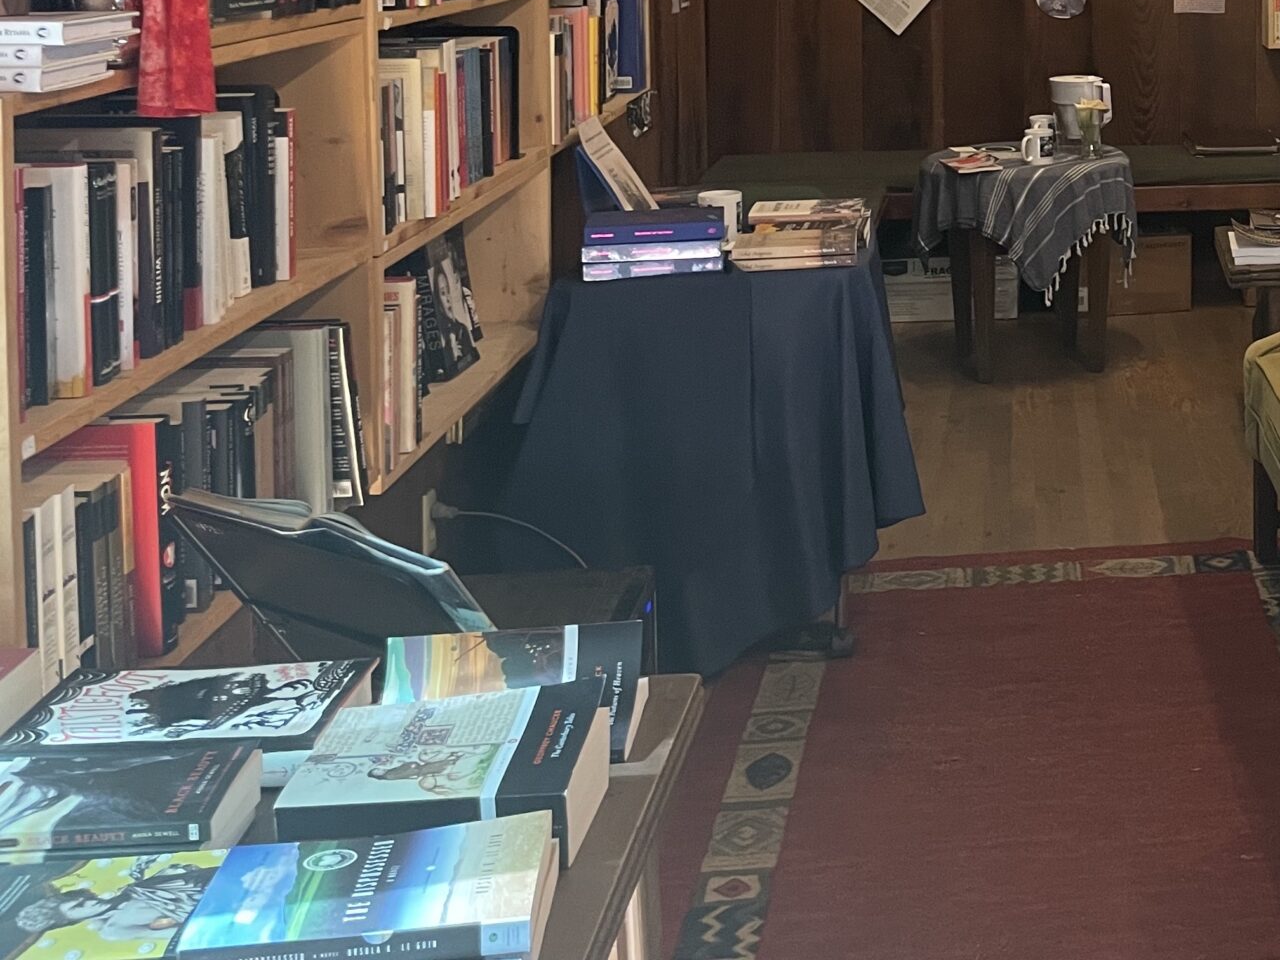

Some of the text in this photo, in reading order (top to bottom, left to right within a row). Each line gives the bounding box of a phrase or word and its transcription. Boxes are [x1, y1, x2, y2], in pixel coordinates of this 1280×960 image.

[154, 257, 163, 304] WITHIN
[416, 273, 443, 352] MIRAGES
[613, 661, 624, 687] Heaven
[546, 708, 563, 738] CHAUCER
[550, 746, 561, 759] The
[556, 724, 575, 750] Canterbury
[164, 750, 218, 815] BLACK BEAUTY
[74, 831, 126, 845] BEAUTY
[131, 829, 180, 840] ANNA SEWELL
[342, 839, 397, 925] THE DISPOSSESSED
[346, 939, 438, 958] URSULA LE GUIN
